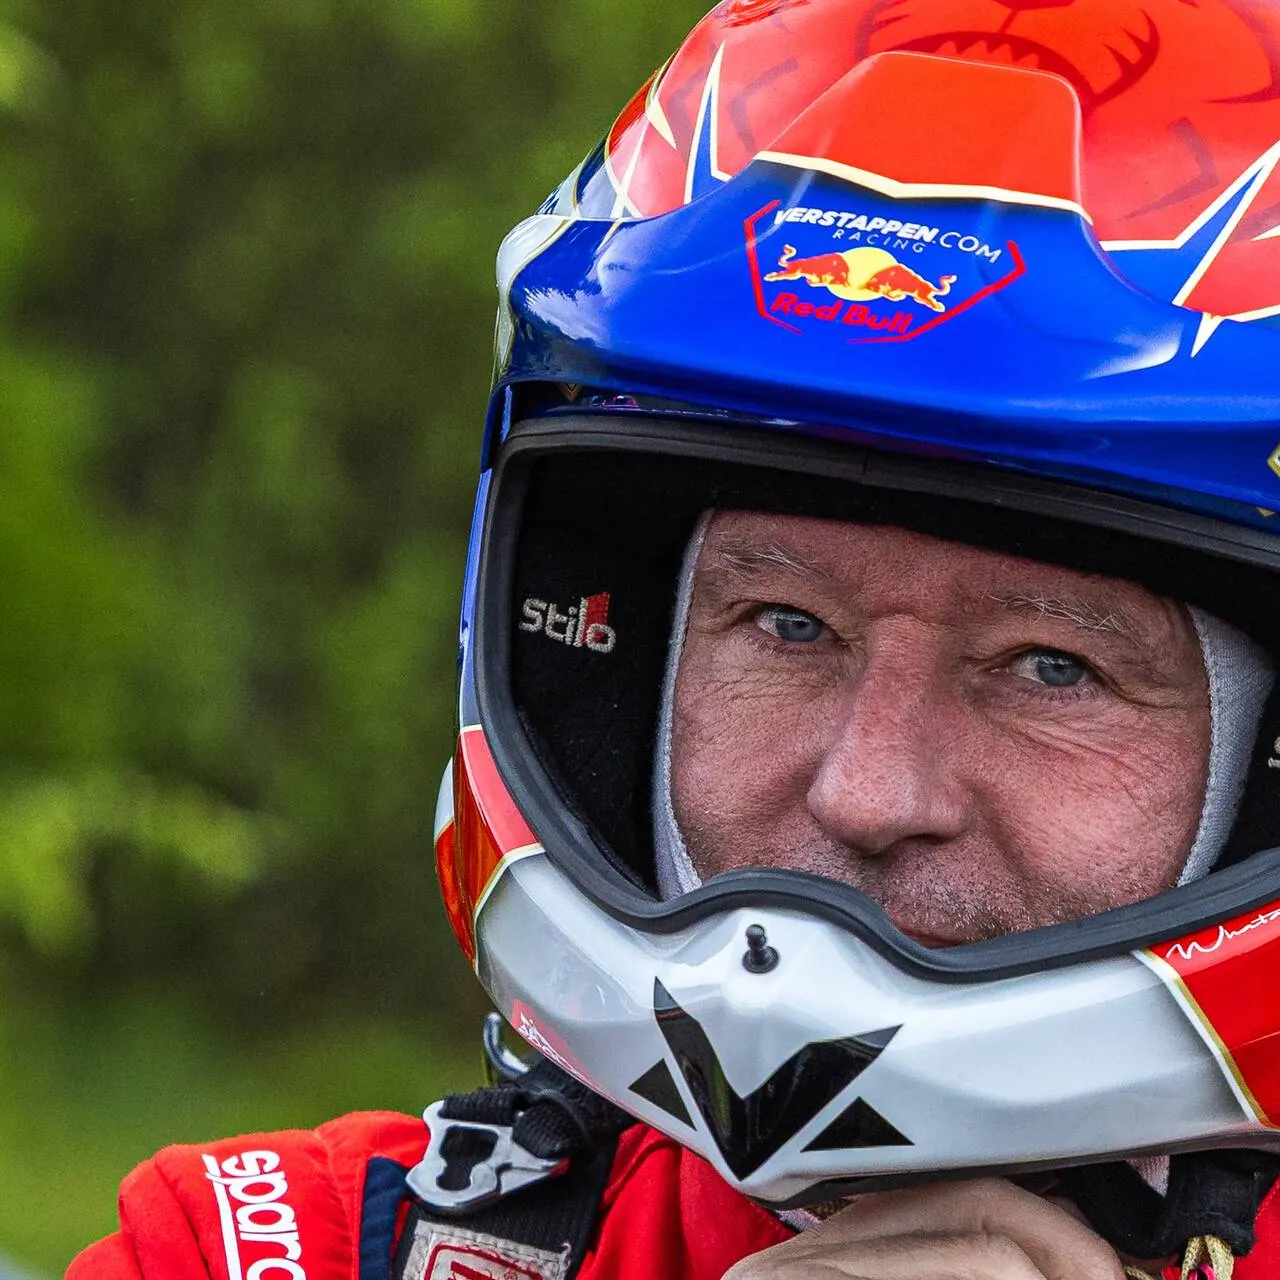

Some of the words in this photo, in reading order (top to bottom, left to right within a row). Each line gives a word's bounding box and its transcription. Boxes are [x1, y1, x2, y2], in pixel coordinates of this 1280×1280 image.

[773, 207, 1002, 264] VERSTAPPEN.COM
[832, 229, 926, 254] RACING
[771, 292, 843, 321] Red
[843, 304, 913, 334] Bull
